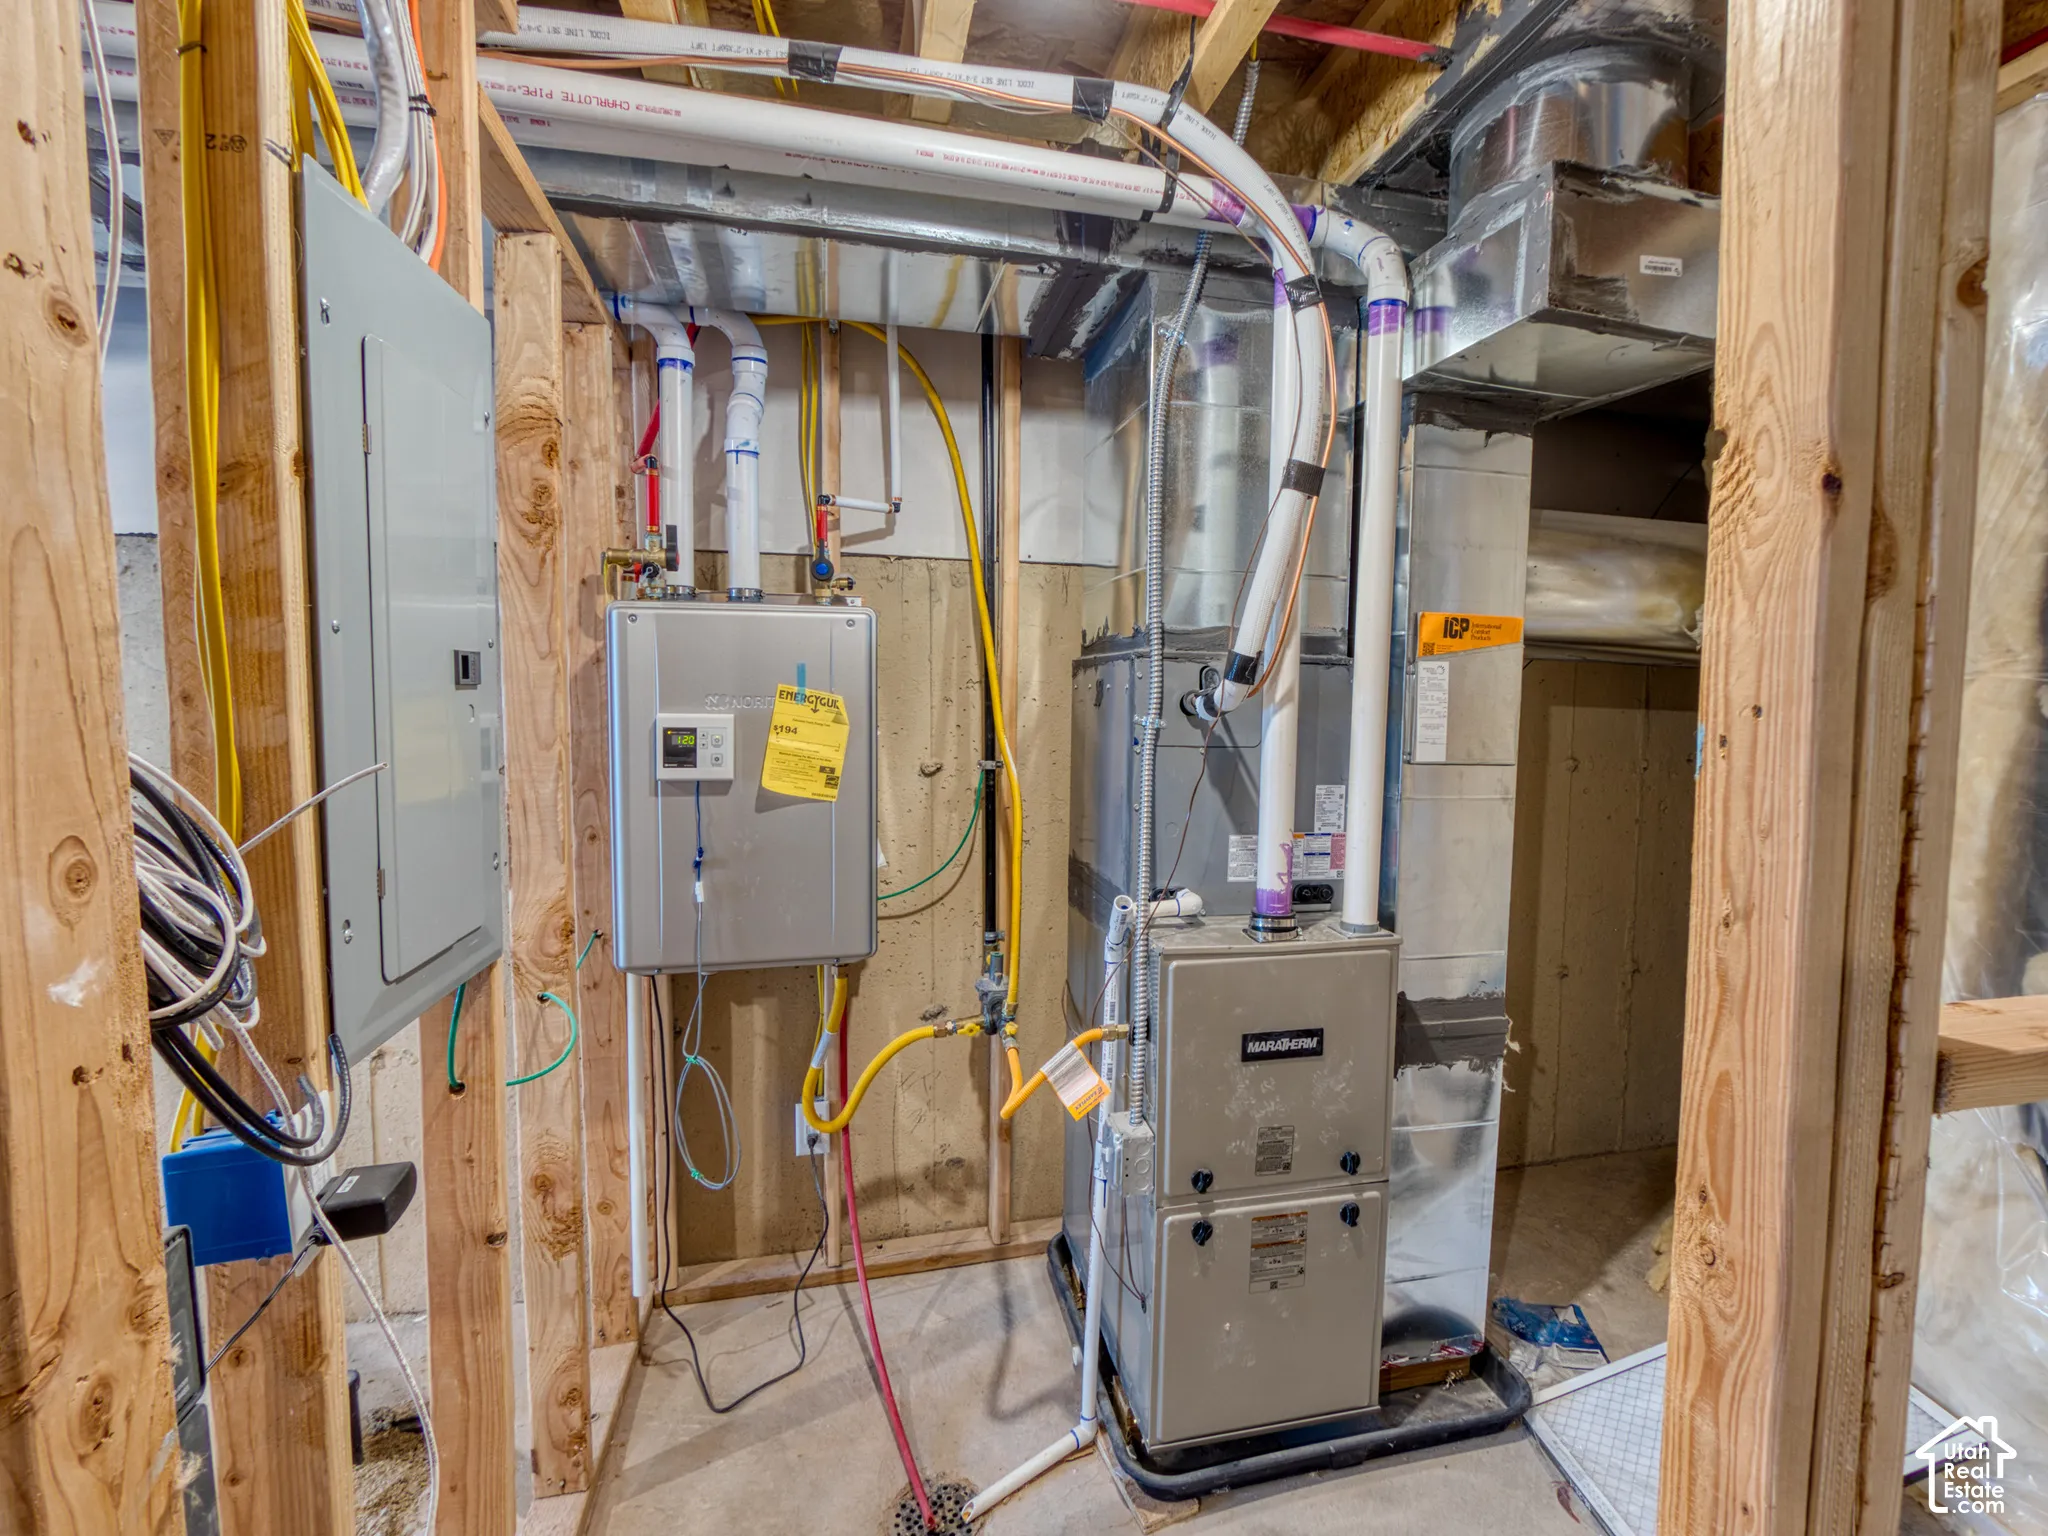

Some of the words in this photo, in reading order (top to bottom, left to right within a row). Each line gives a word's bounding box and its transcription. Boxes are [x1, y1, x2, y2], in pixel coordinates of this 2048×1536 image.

[336, 2, 357, 12] COOL
[521, 85, 553, 100] PIPE
[560, 91, 630, 111] CHARLOTTE
[731, 695, 775, 709] NORIT
[778, 689, 840, 711] ENERGYGUI
[774, 724, 798, 735] $194
[677, 735, 695, 745] 120
[1246, 1037, 1318, 1053] MARATHERM
